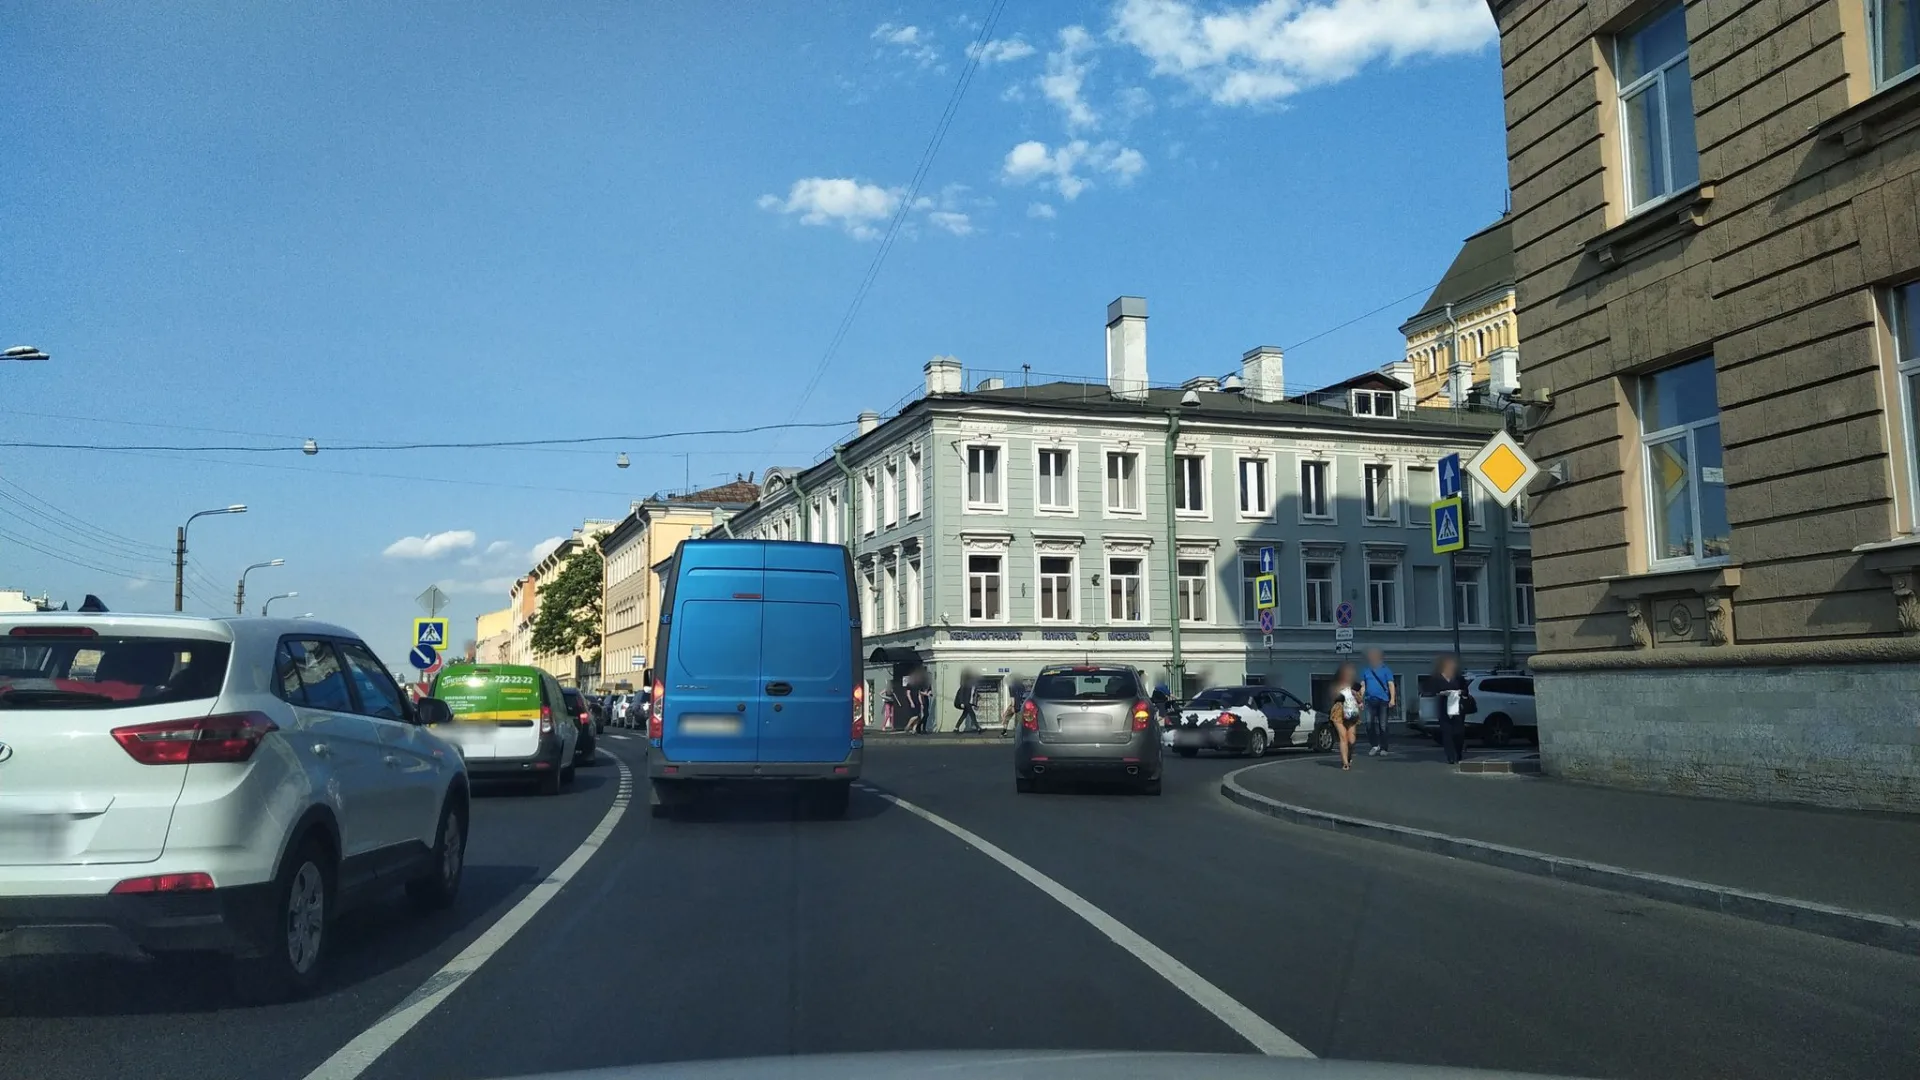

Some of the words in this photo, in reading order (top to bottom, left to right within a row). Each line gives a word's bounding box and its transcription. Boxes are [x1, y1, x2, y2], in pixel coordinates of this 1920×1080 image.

[950, 631, 1023, 641] КЕРАМОГРАНИТ
[1042, 631, 1078, 641] ПЛИТКА
[1108, 631, 1151, 641] МОЗАИКА
